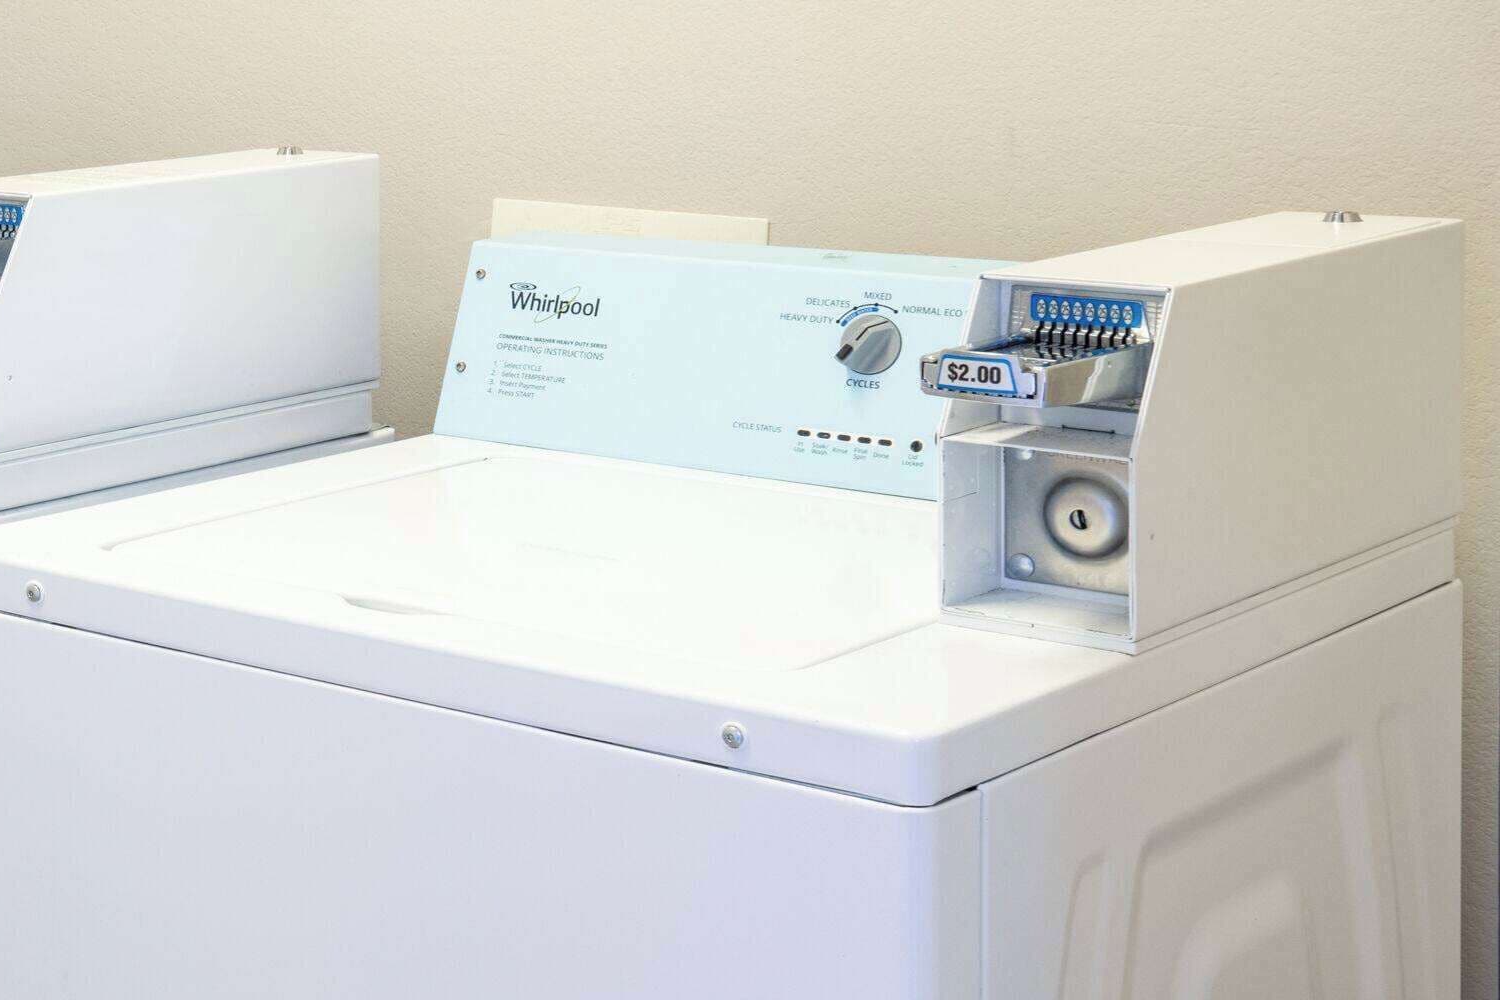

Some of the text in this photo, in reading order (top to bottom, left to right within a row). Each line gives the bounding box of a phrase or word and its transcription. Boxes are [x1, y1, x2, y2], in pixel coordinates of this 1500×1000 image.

[864, 291, 892, 301] MIXED
[510, 290, 600, 319] Whirlpool
[806, 297, 851, 308] DELICATES
[902, 305, 963, 317] NORMAL ECO
[780, 313, 808, 322] HEAVY
[809, 314, 834, 324] DUTY
[499, 333, 533, 342] COMMERCIAL
[574, 340, 589, 348] DUTY
[590, 342, 607, 350] SERIES
[496, 342, 605, 361] OPERATING INSTRUCTIONS
[947, 361, 1002, 384] $2.00
[521, 373, 566, 384] TEMPERATURE
[846, 378, 880, 389] CYCLES
[515, 390, 535, 398] START
[732, 420, 782, 433] CYCLE STATUS
